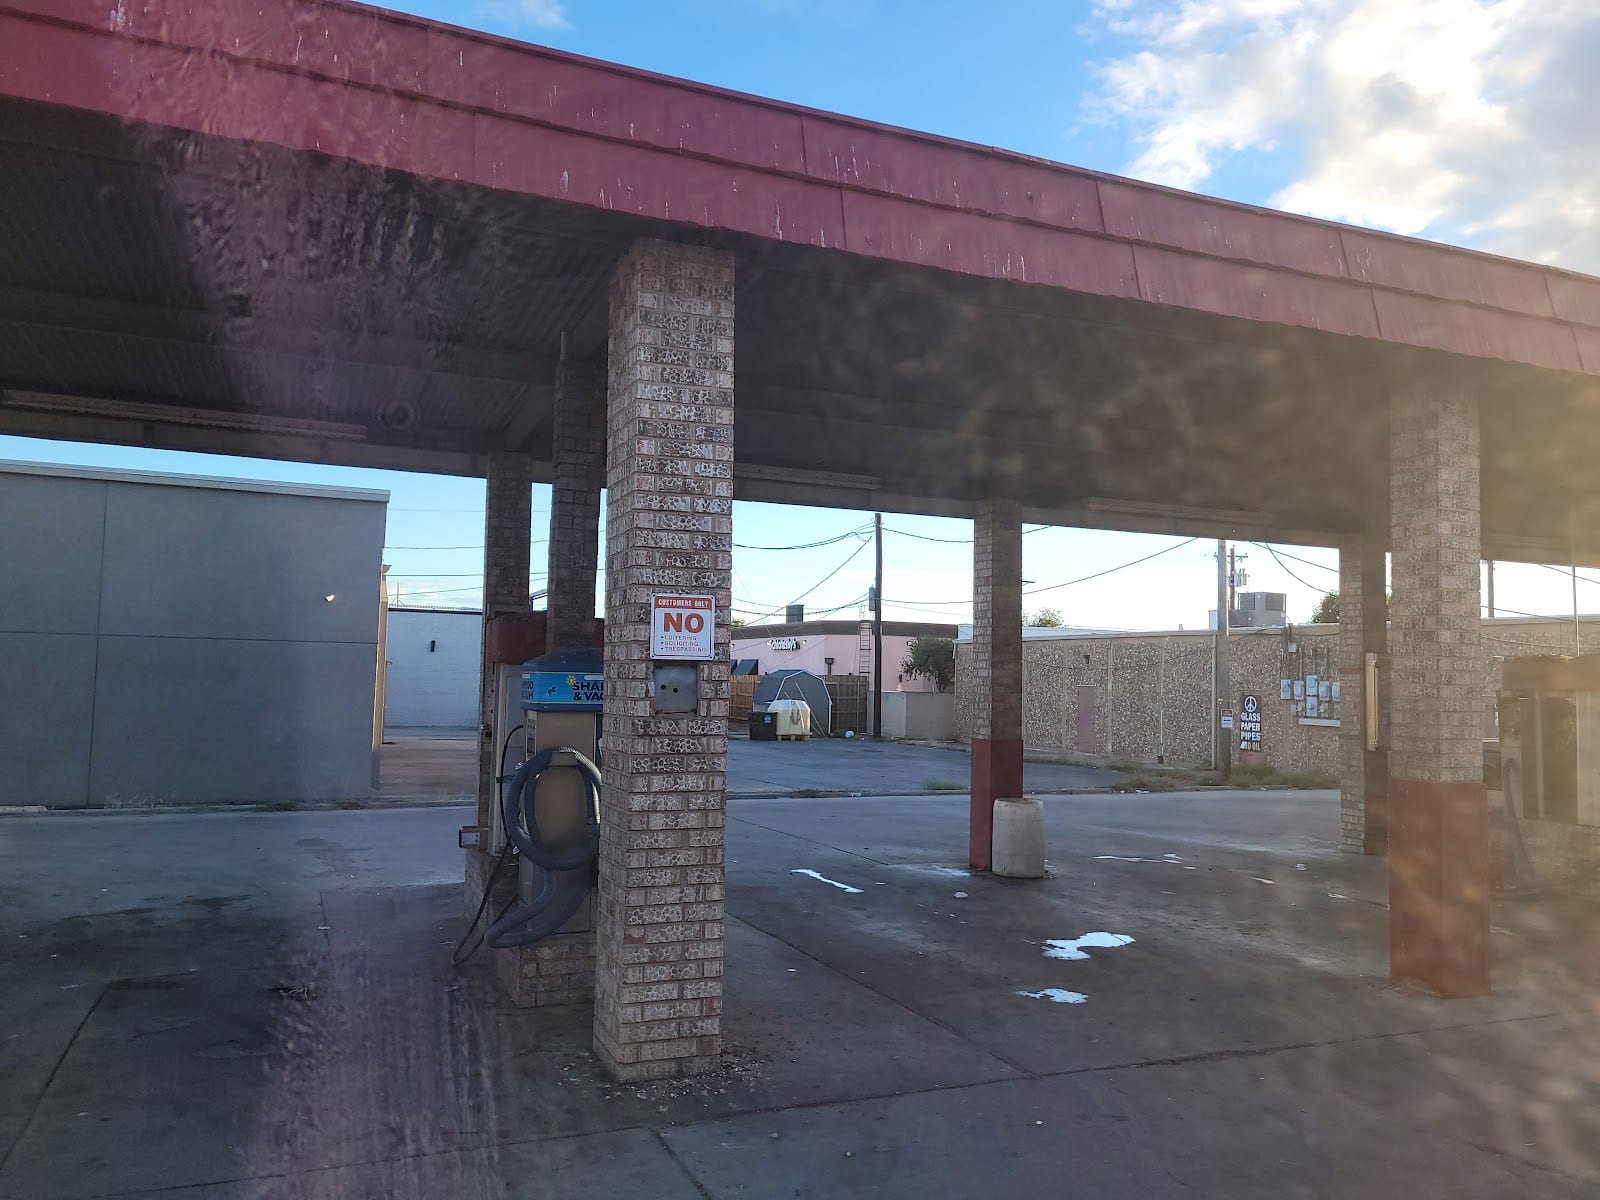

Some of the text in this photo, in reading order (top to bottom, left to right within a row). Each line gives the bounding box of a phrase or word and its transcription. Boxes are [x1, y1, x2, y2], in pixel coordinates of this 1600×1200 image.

[658, 599, 709, 608] CUSTOMERS ONLY
[663, 612, 705, 634] NO
[573, 691, 583, 701] &
[1241, 712, 1261, 722] GLASS
[1240, 722, 1261, 732] PAPER
[1240, 731, 1261, 742] PIPES
